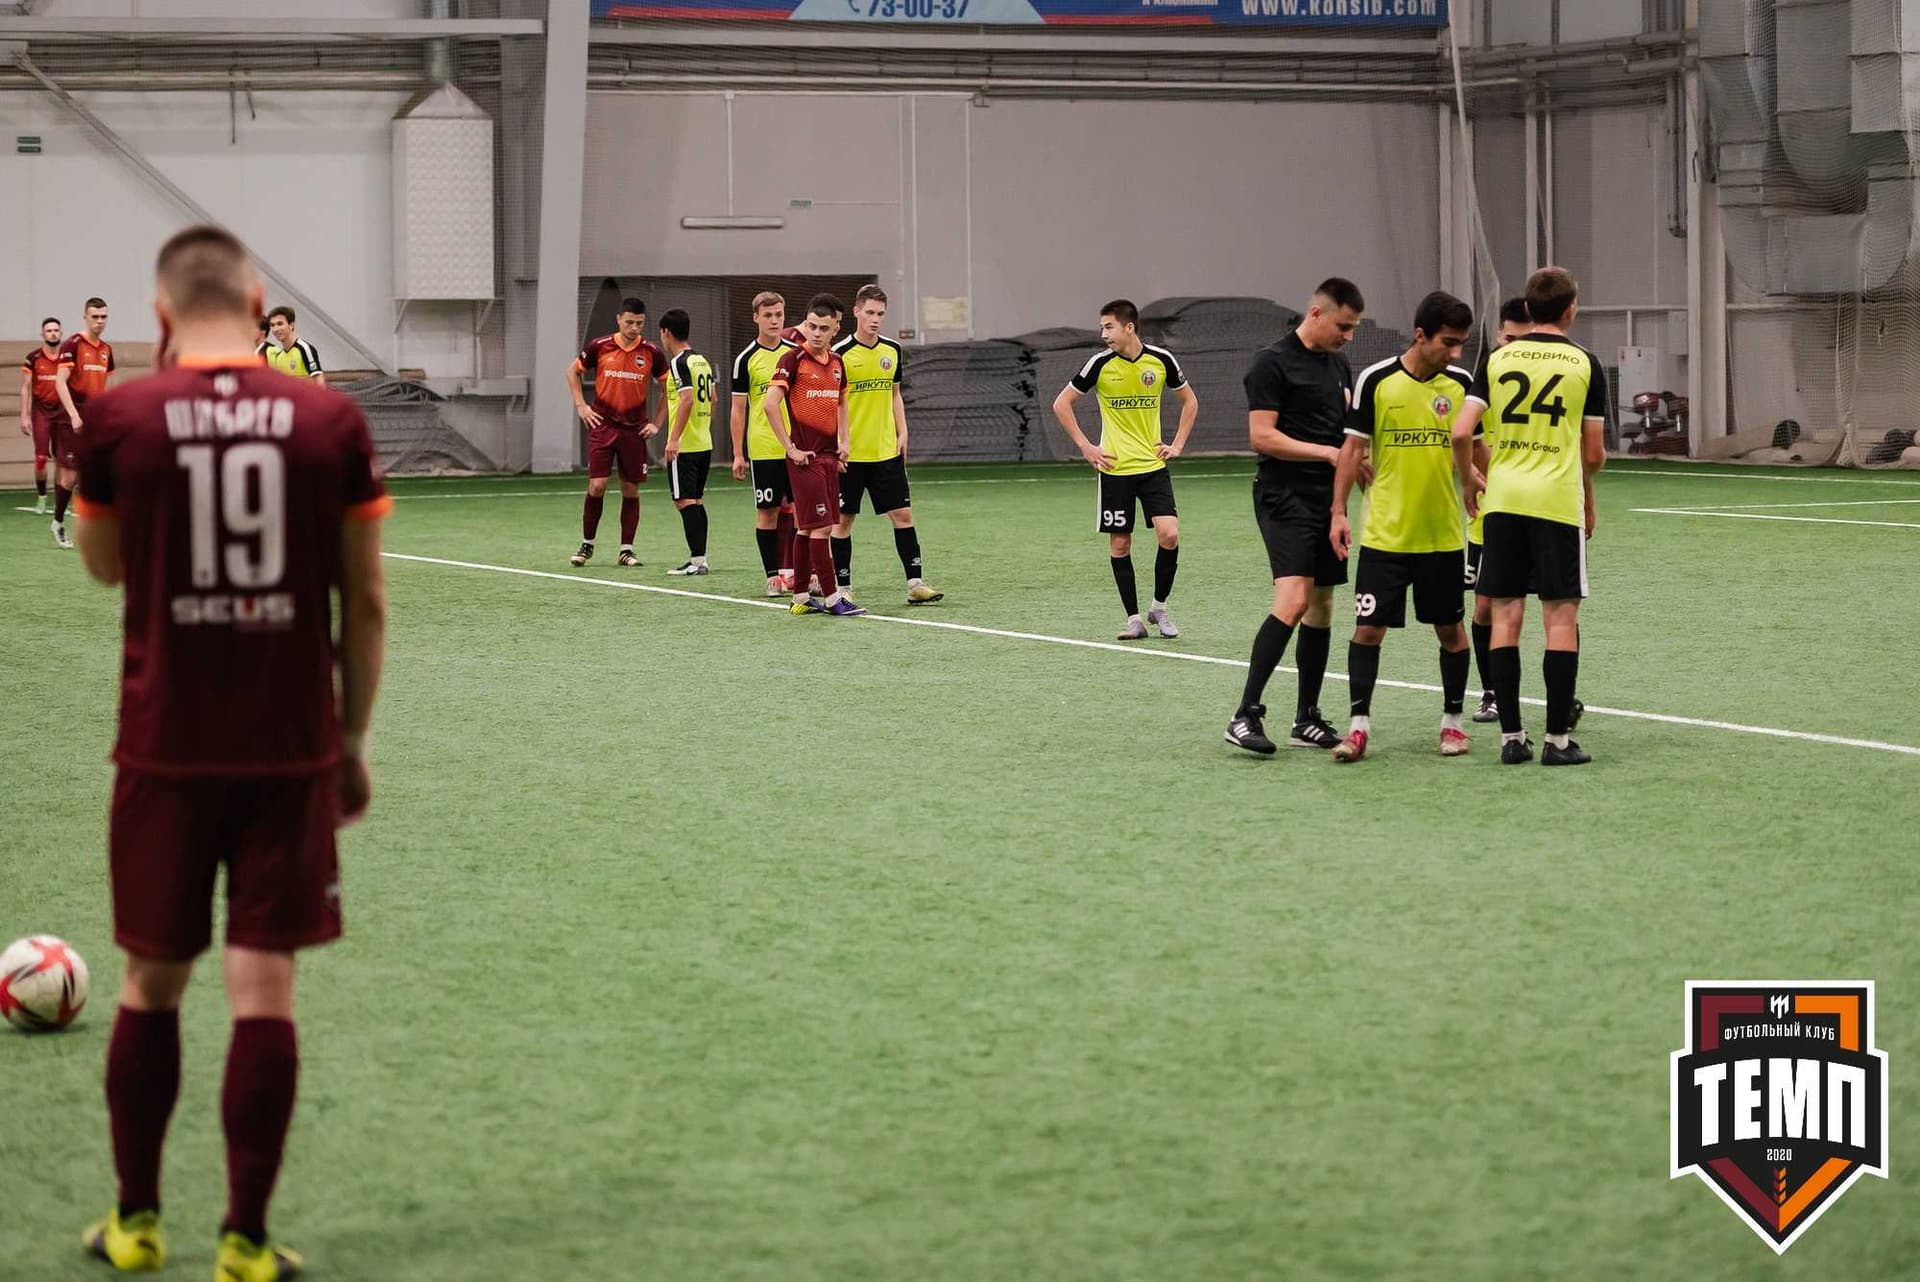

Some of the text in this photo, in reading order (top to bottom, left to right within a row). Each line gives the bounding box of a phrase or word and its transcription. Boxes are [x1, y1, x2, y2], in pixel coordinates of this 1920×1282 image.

[1111, 398, 1157, 408] ИРКУТСК
[1498, 370, 1567, 427] 24
[1532, 441, 1560, 453] Group
[755, 487, 773, 503] 90
[176, 442, 286, 589] 19
[1103, 510, 1127, 527] 95
